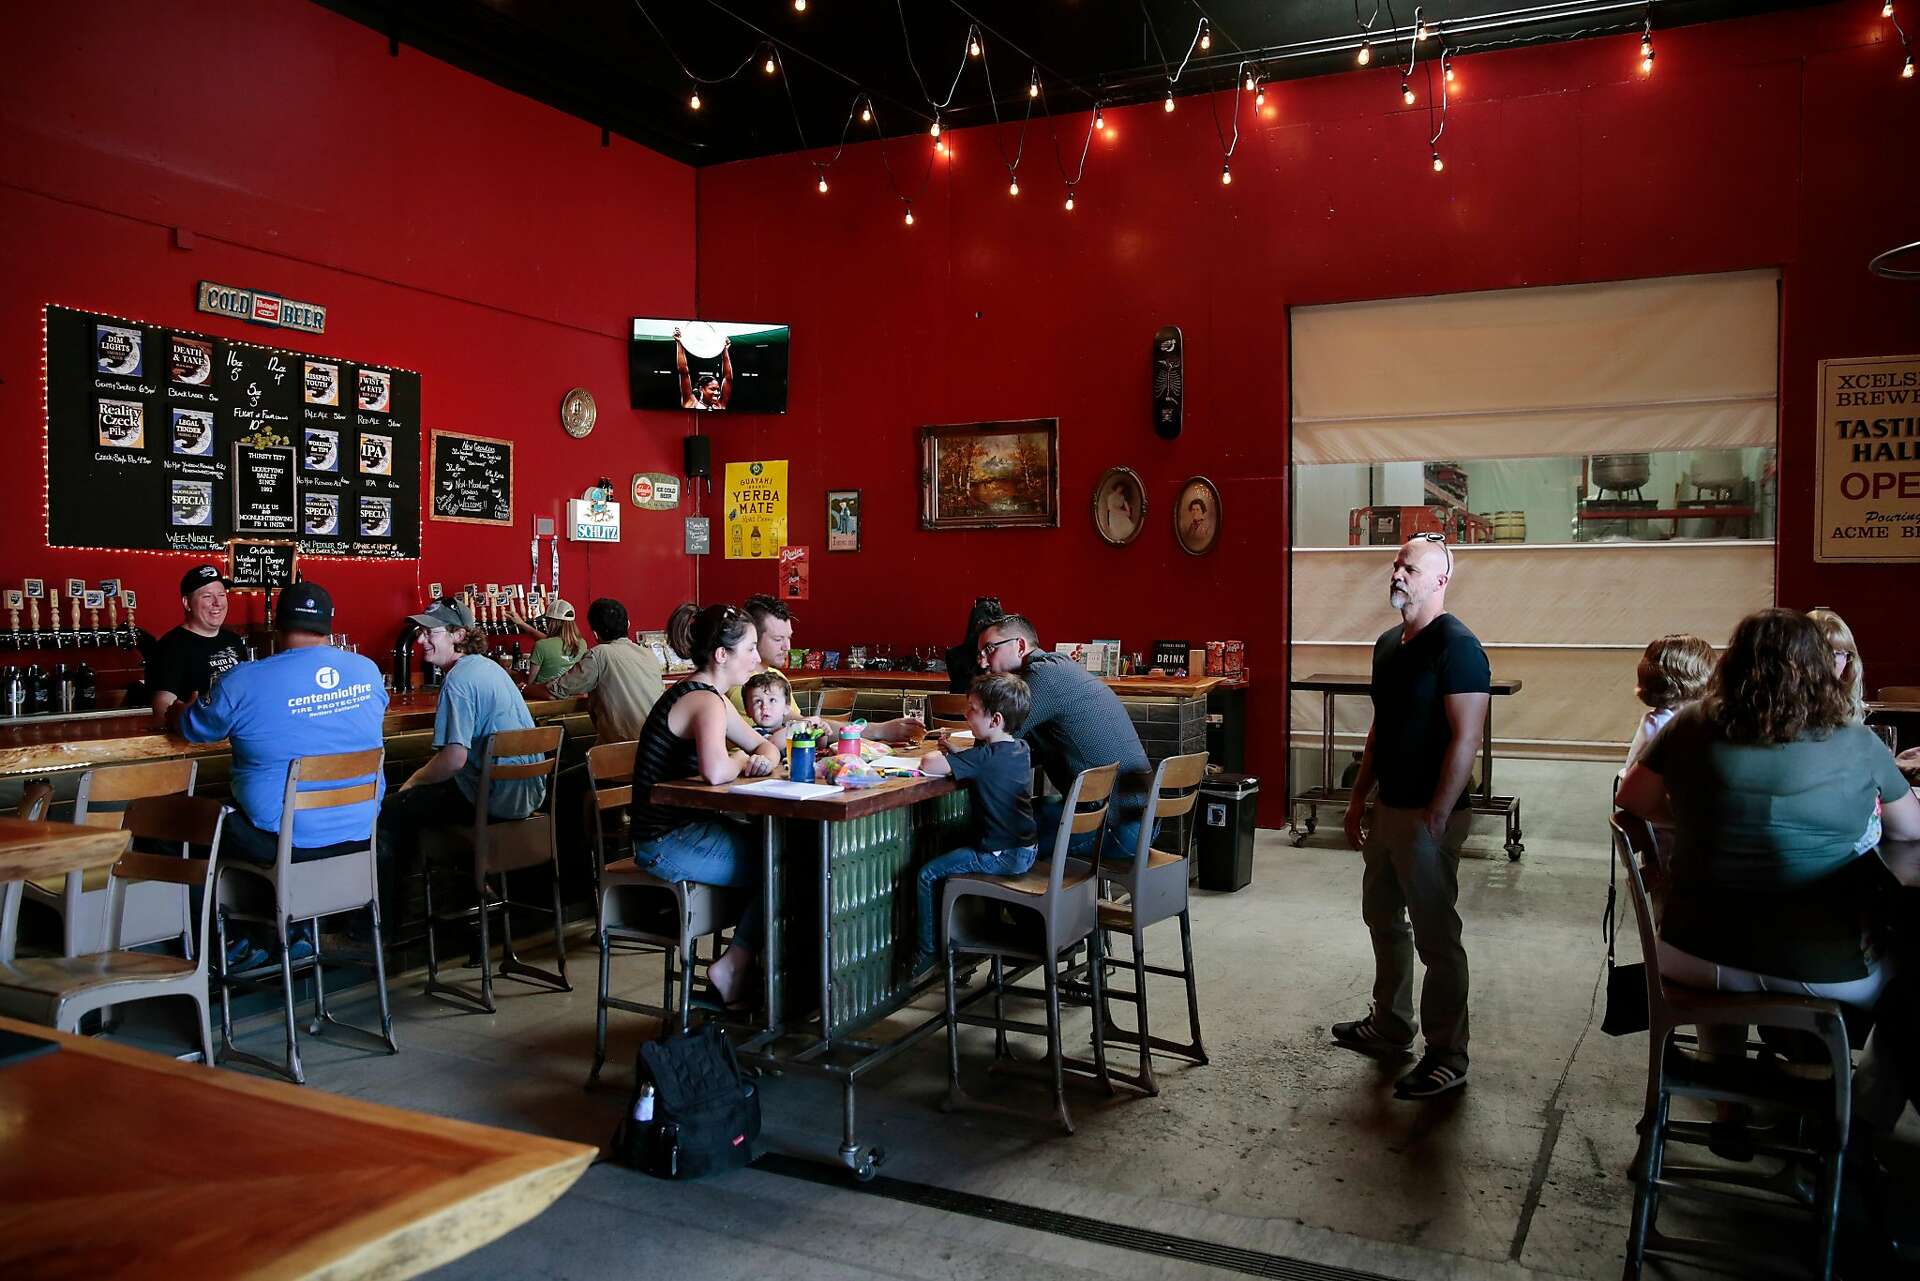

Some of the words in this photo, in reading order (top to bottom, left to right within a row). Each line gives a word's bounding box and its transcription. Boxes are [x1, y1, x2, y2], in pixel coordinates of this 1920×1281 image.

[207, 287, 250, 314] COLD
[283, 304, 324, 330] BEER
[108, 335, 124, 344] DIM
[101, 342, 130, 352] LIGHTS
[172, 344, 202, 357] DEATH
[173, 354, 180, 362] &
[360, 376, 381, 386] TWIST
[1837, 371, 1920, 390] XCELS
[367, 385, 384, 394] FATE
[99, 403, 142, 419] Reality
[102, 413, 139, 427] Czeck
[178, 418, 200, 427] LEGAL
[109, 427, 126, 437] Pils
[175, 425, 202, 434] TENDER
[1836, 417, 1920, 440] TASTI
[248, 452, 272, 461] THIRSTY
[361, 444, 383, 459] IPA
[1840, 472, 1920, 501] OPE
[171, 495, 209, 505] SPECIAL
[733, 490, 780, 503] YERBA
[304, 507, 338, 516] SPECIAL
[740, 502, 774, 514] MATE
[360, 509, 389, 519] SPECIAL
[576, 524, 618, 540] SCHLITZ
[1832, 526, 1889, 539] ACME
[1157, 654, 1185, 664] DRINK
[291, 707, 313, 715] FIRE
[317, 694, 371, 710] PROTECTION
